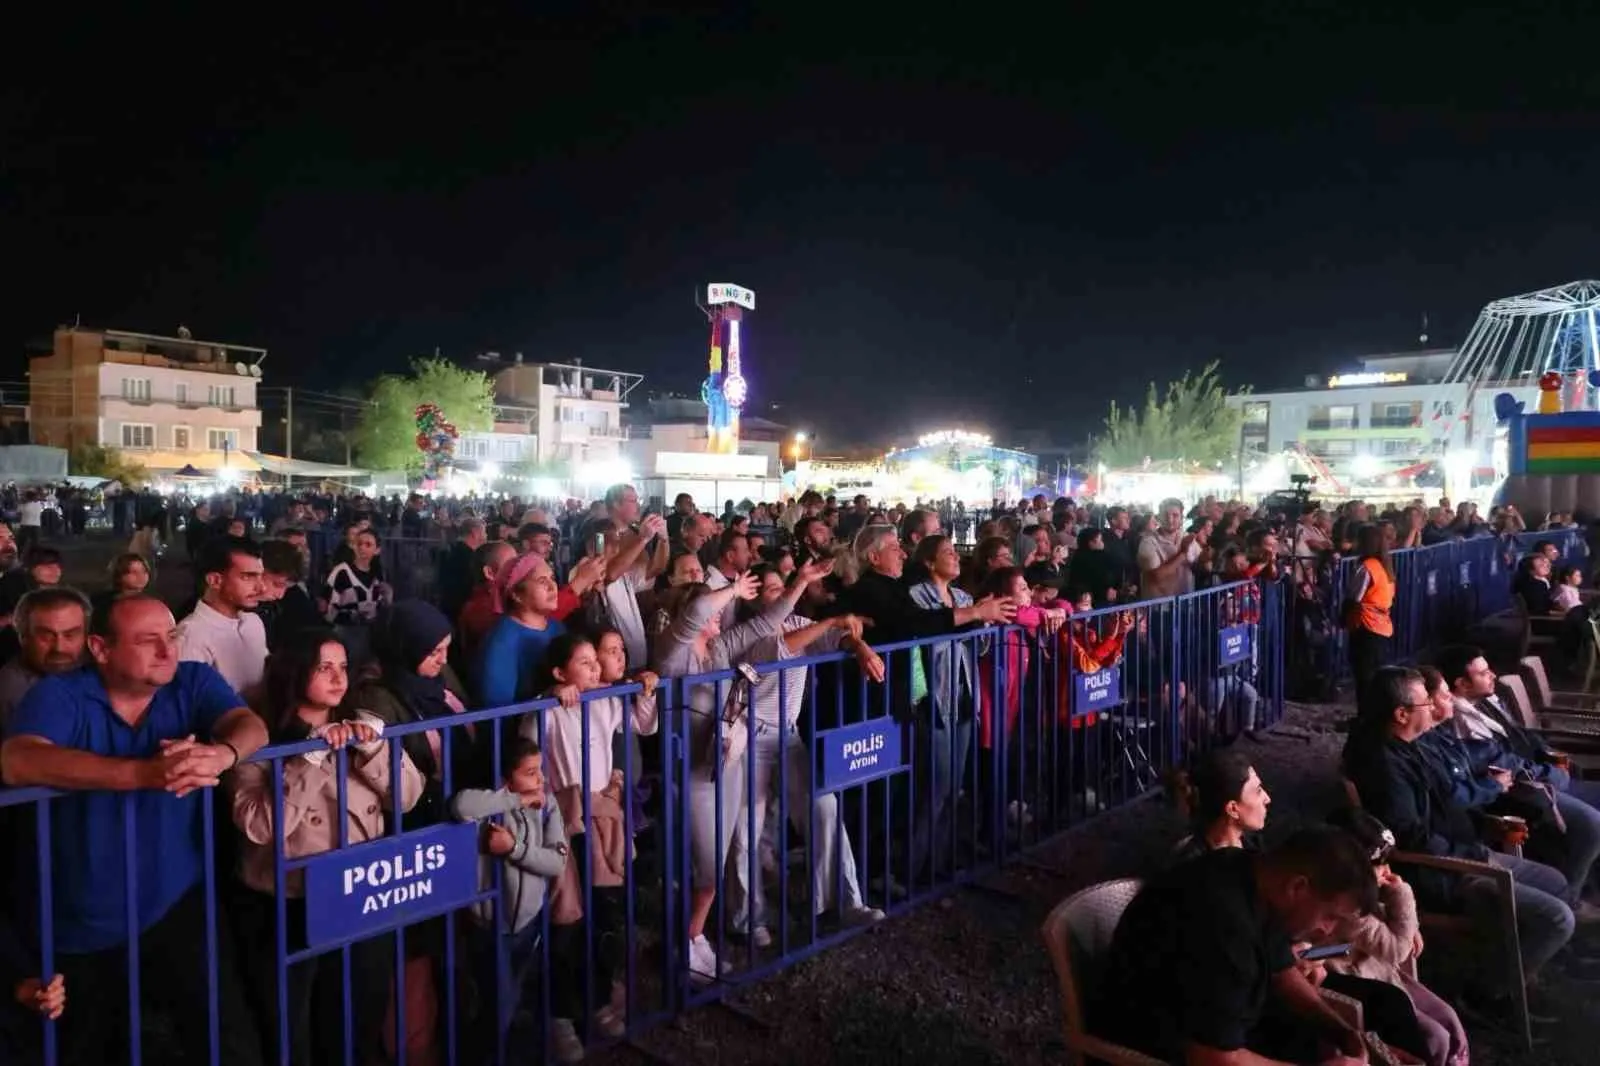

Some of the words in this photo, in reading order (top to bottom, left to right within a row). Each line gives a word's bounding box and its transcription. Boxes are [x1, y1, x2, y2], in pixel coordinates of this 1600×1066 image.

[712, 287, 751, 303] RANGR
[843, 733, 884, 759] POLİS
[849, 754, 878, 771] AYDIN
[344, 844, 446, 895] POLİS
[362, 879, 432, 914] AYDIN
